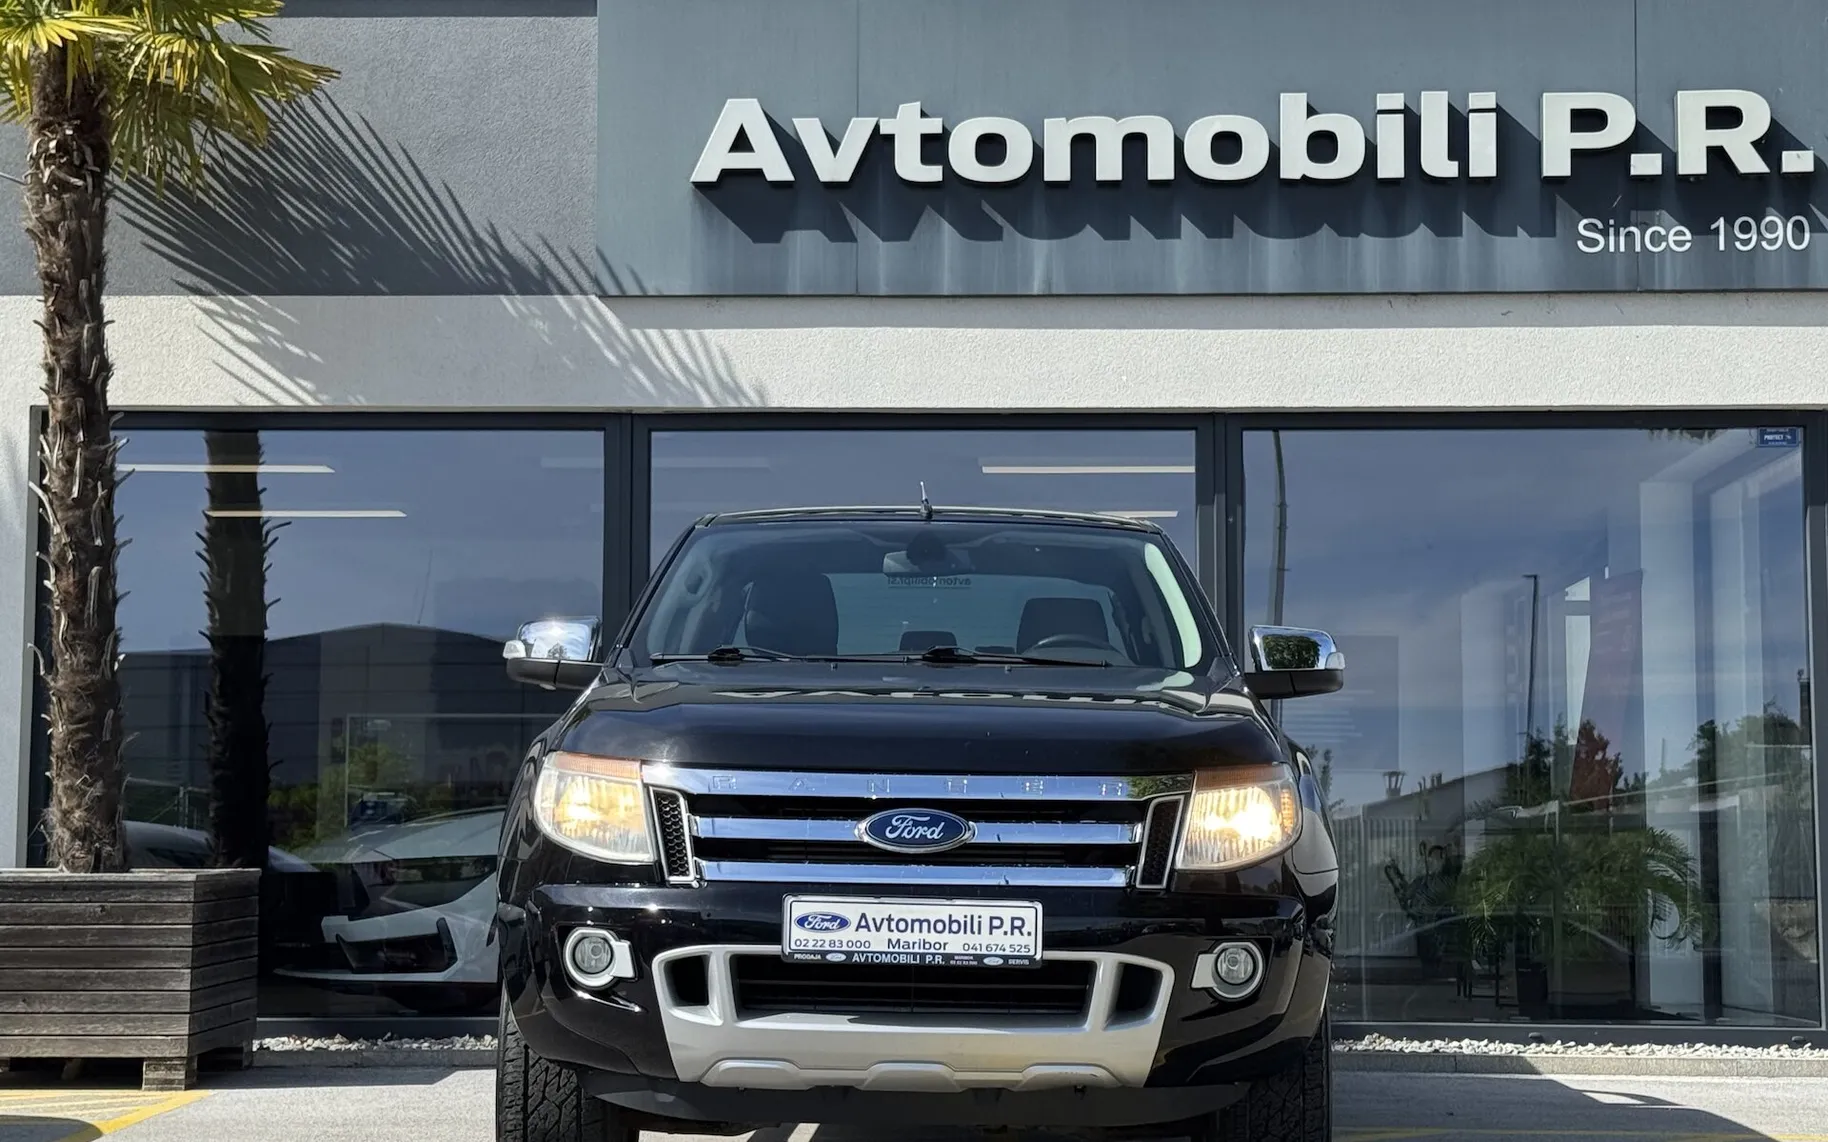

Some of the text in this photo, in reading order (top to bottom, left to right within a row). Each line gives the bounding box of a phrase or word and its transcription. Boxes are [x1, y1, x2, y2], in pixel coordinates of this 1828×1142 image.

[690, 89, 1815, 183] Avtomobili P.R.
[1576, 215, 1811, 254] Since 1990
[884, 814, 944, 841] Ford
[802, 914, 842, 931] Ford
[855, 912, 1033, 937] Avtomobili P.R.
[794, 938, 871, 949] 02 22 83 000
[887, 938, 949, 951] Maribor
[962, 942, 1031, 953] 041 674 525
[852, 953, 920, 964] AVTOMOBILI
[925, 954, 946, 965] P.R.
